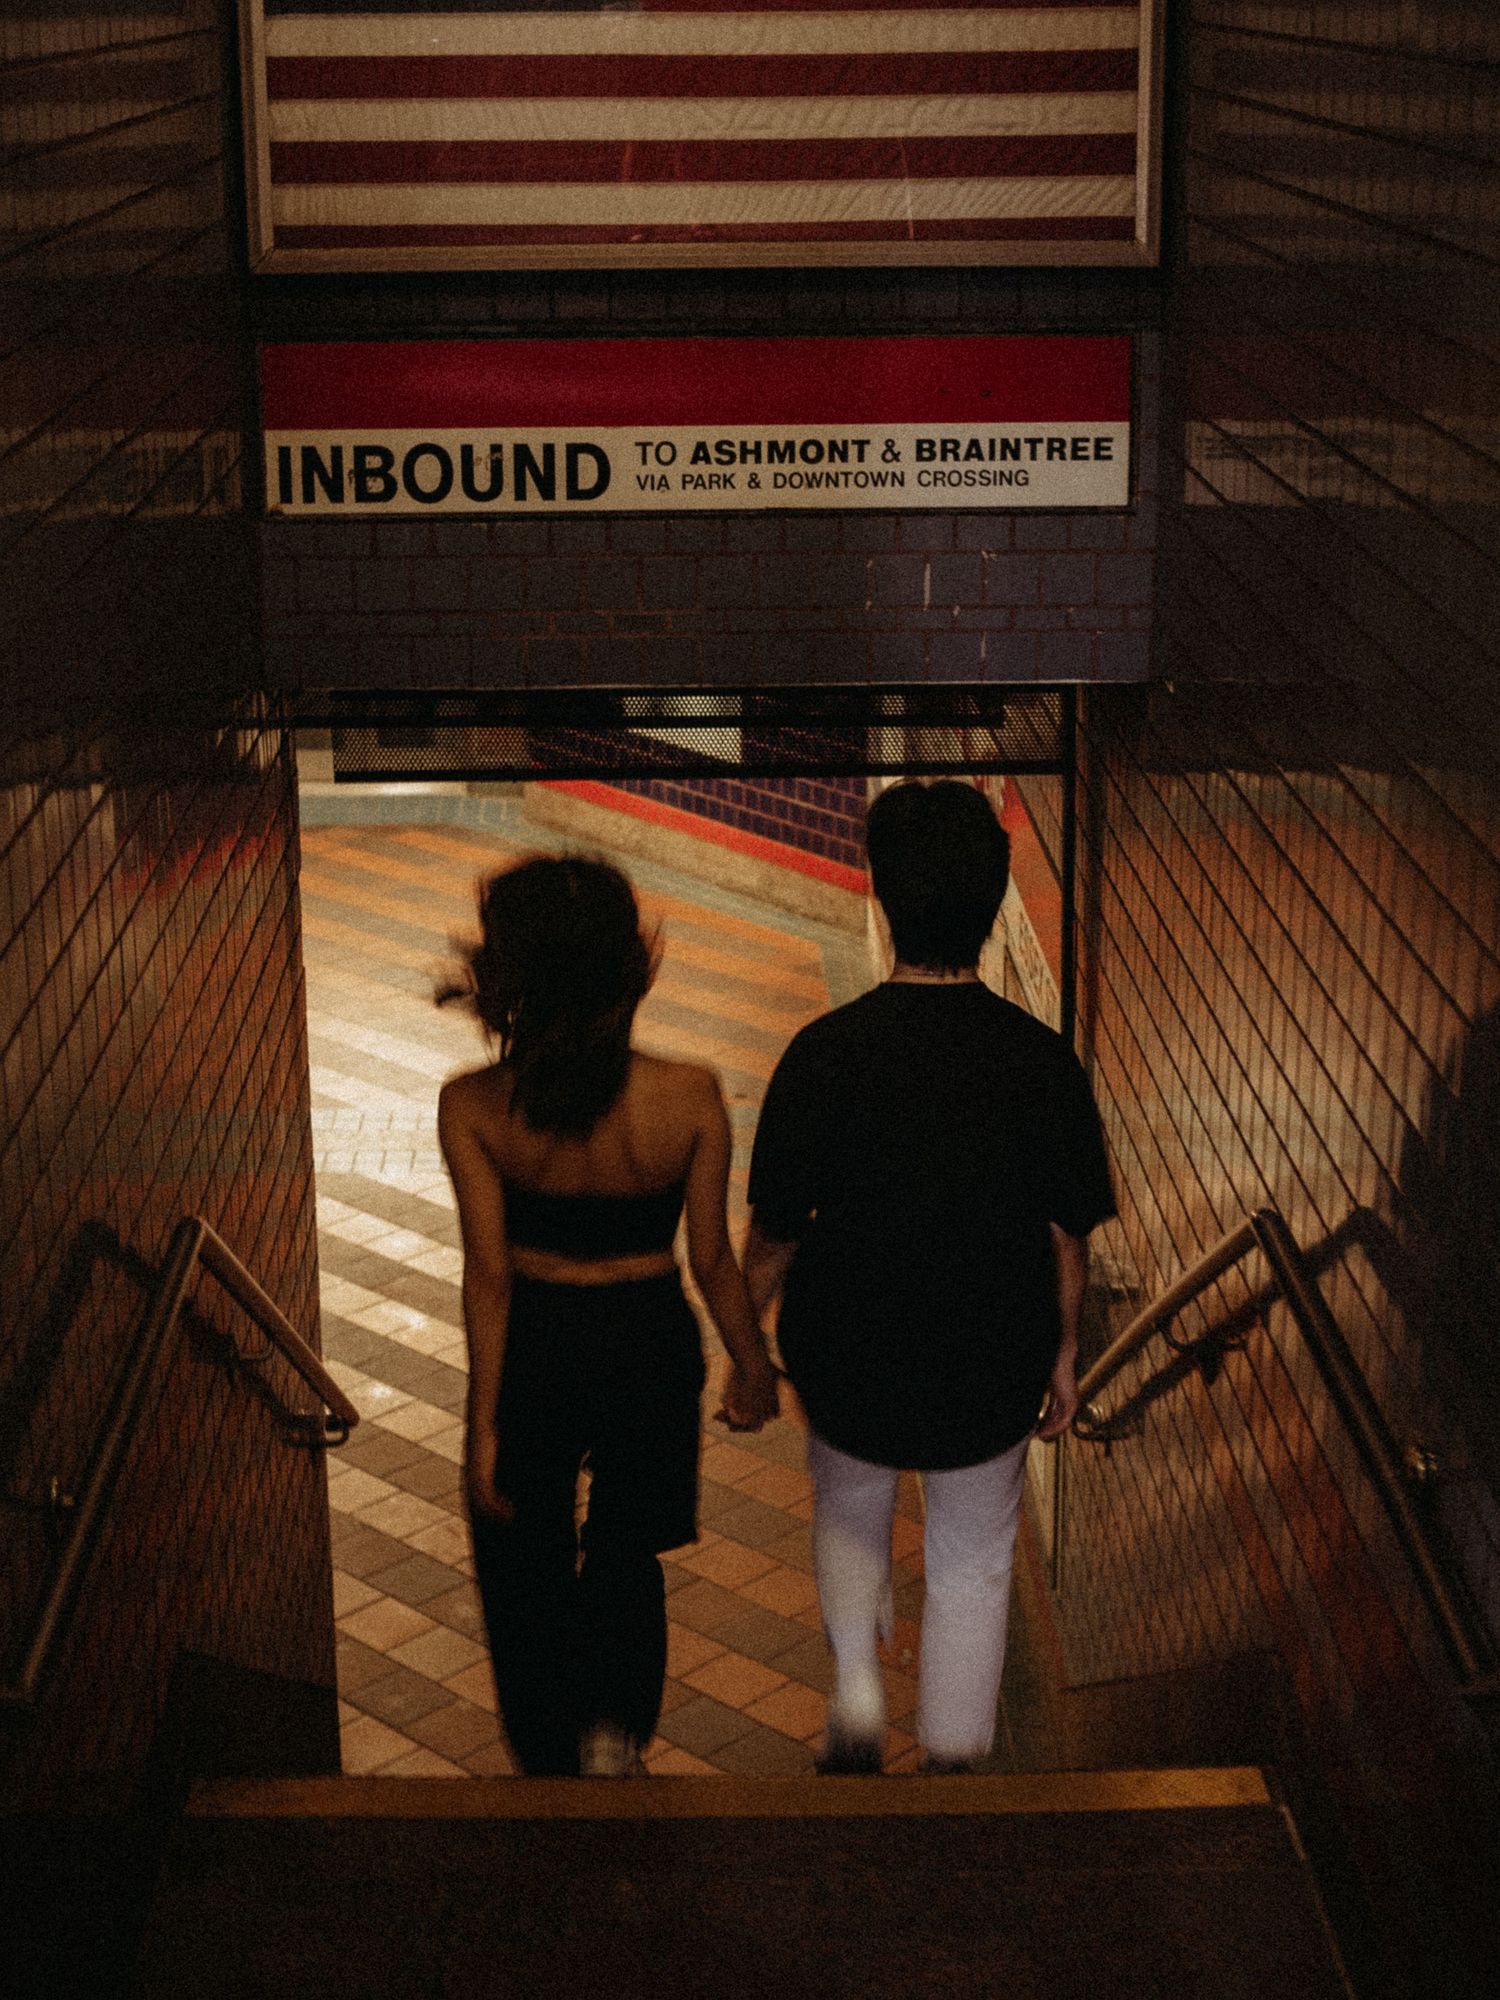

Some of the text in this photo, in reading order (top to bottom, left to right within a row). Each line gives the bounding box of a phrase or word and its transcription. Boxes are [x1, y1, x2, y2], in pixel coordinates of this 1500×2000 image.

[635, 437, 1114, 466] TO ASHMONT & BRAINTREE
[277, 442, 611, 504] INBOUND
[637, 469, 1030, 490] VIA PARK & DOWNTOWN CROSSING
